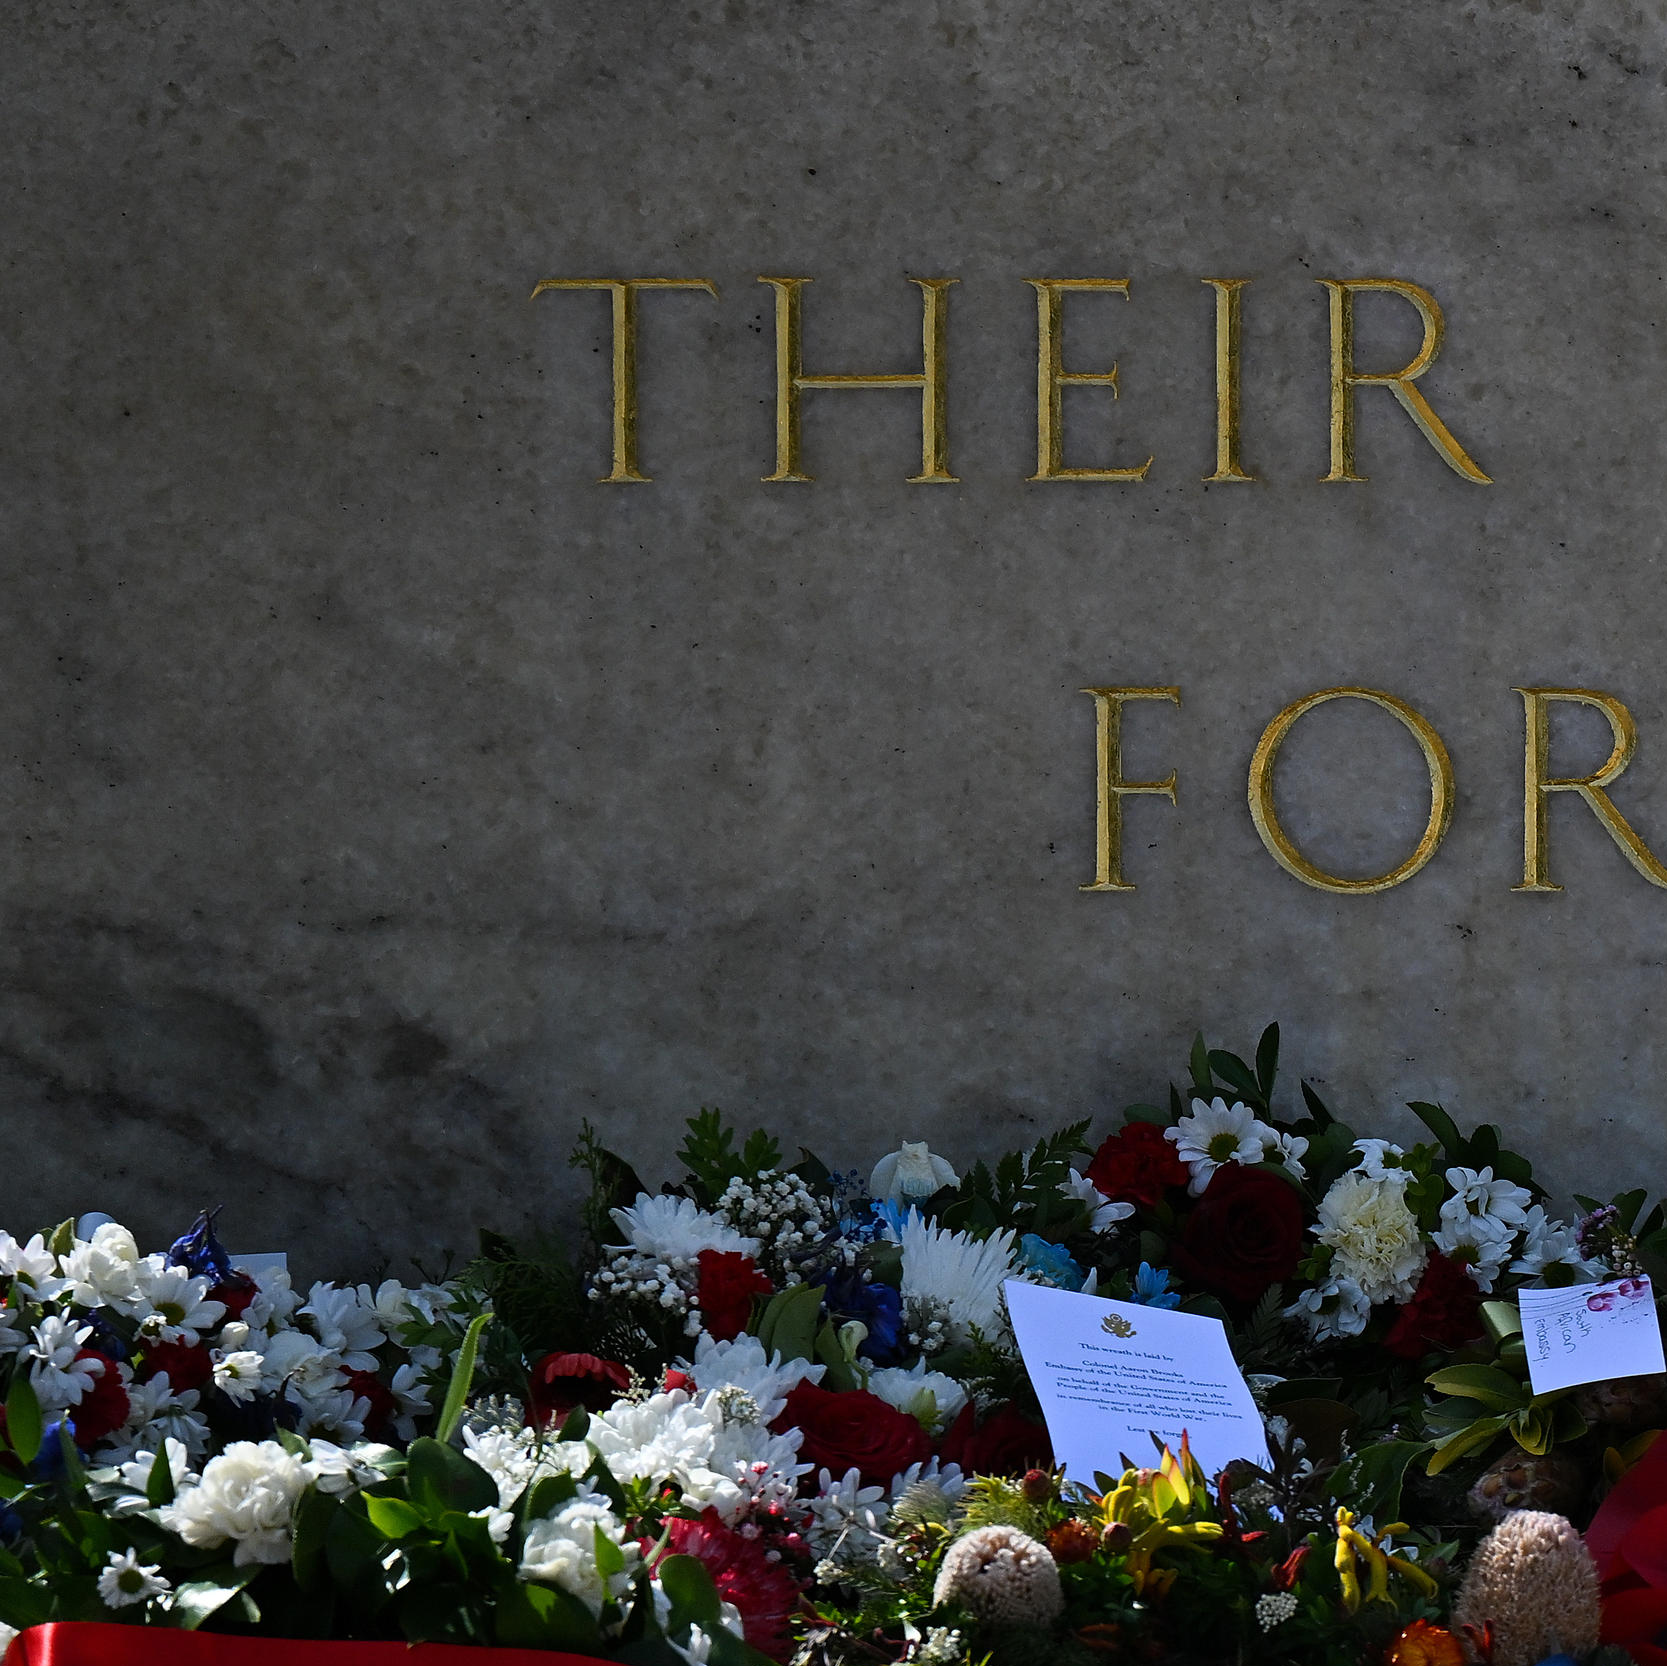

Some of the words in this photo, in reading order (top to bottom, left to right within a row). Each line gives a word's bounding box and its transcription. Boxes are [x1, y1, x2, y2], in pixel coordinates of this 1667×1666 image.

[533, 276, 1493, 484] THEIR
[1554, 1311, 1576, 1354] African
[1575, 1308, 1593, 1338] South
[1078, 1342, 1100, 1351] This
[1101, 1347, 1132, 1356] wreath
[1143, 1352, 1161, 1360] laid
[1045, 1361, 1082, 1372] Embassy
[1114, 1370, 1147, 1379] United
[1149, 1375, 1175, 1383] States
[1189, 1380, 1227, 1388] America
[1082, 1360, 1118, 1369] Colonel
[1056, 1382, 1087, 1390] People
[1118, 1389, 1152, 1398] United
[1153, 1393, 1180, 1401] States
[1194, 1398, 1233, 1406] America
[1071, 1377, 1100, 1386] behalf
[1130, 1384, 1188, 1395] Government
[1069, 1395, 1130, 1406] remembrance
[1198, 1409, 1220, 1417] their
[1150, 1410, 1180, 1419] World
